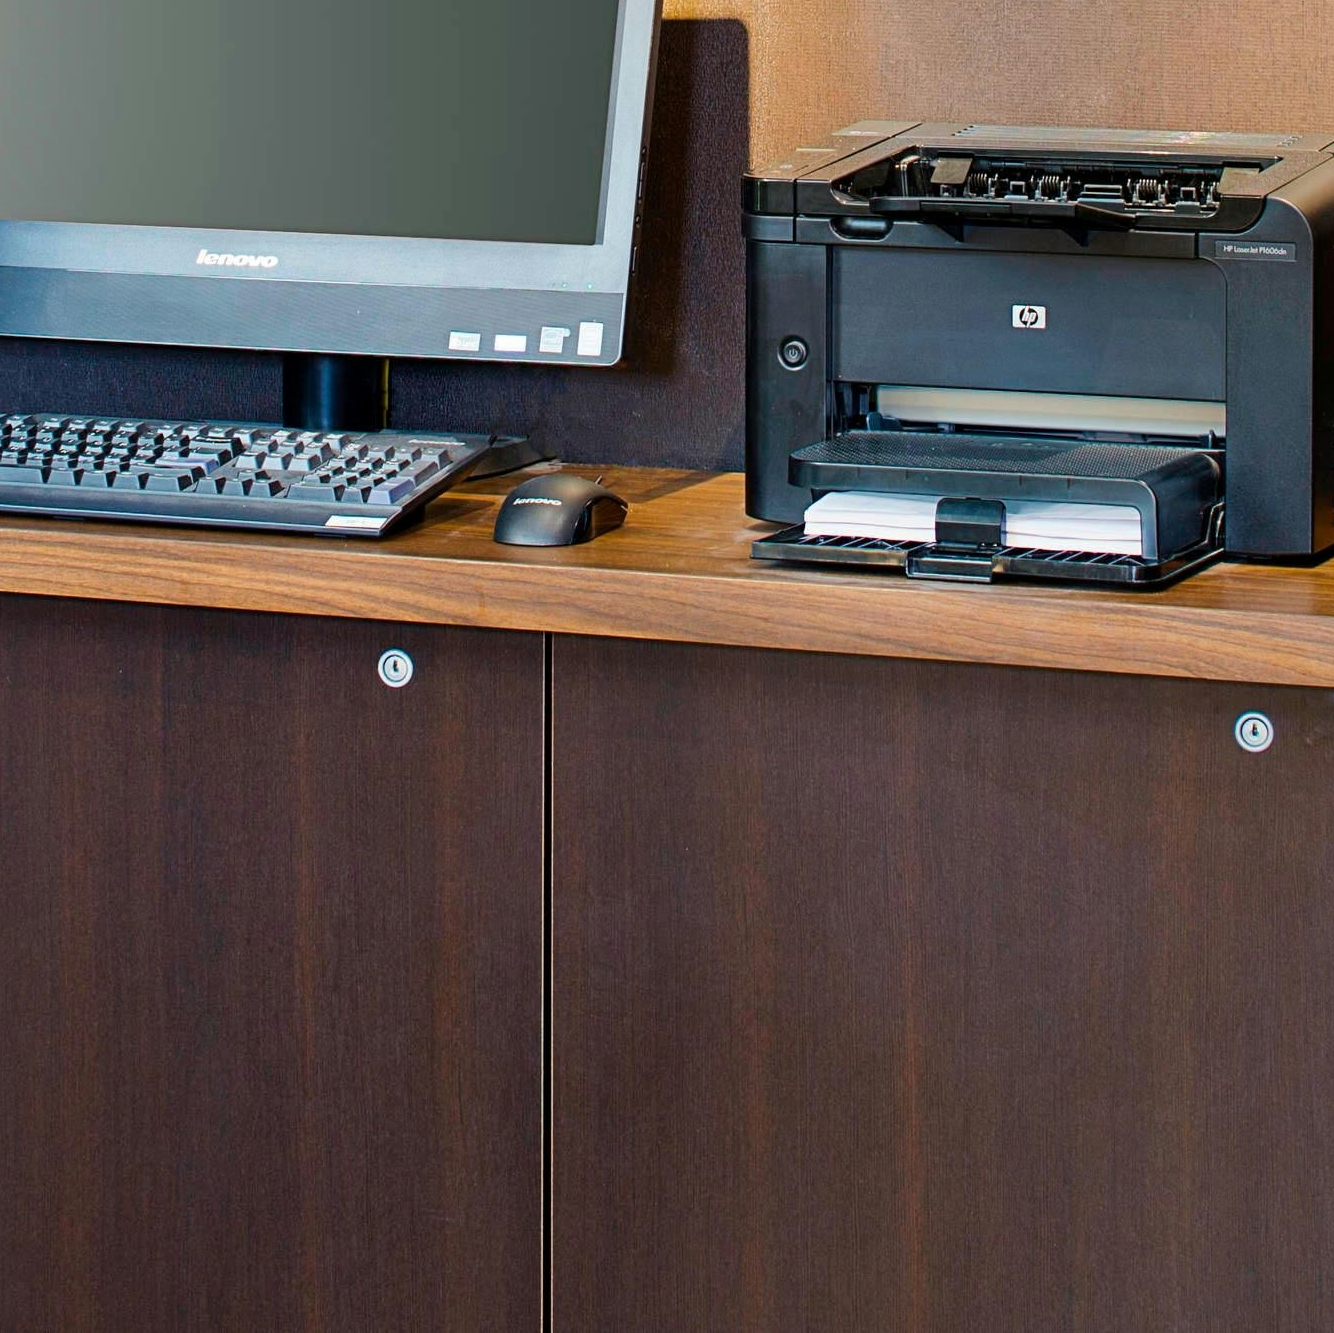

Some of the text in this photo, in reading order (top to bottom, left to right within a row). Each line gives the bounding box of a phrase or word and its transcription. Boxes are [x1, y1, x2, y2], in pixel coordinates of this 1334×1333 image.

[1234, 246, 1258, 254] LaserJet
[195, 249, 279, 267] lenovo
[513, 497, 562, 506] lenovo
